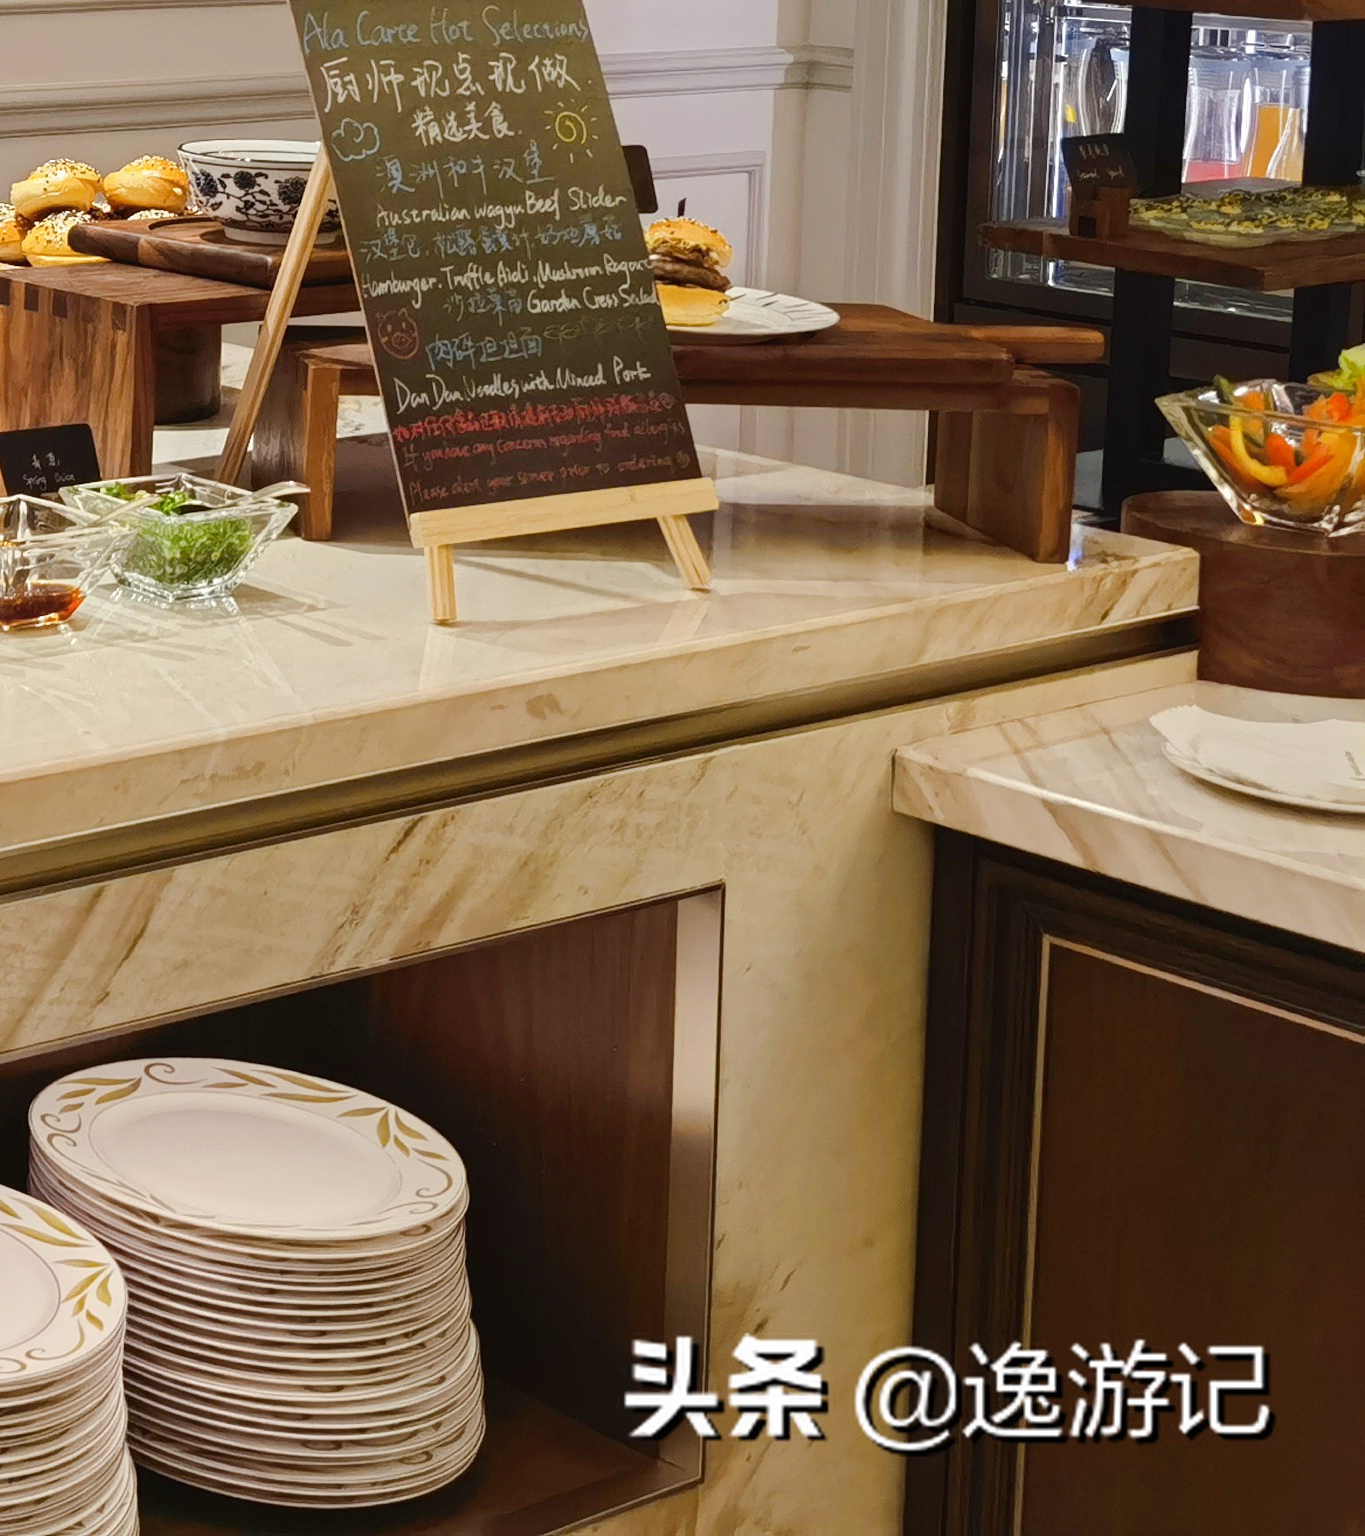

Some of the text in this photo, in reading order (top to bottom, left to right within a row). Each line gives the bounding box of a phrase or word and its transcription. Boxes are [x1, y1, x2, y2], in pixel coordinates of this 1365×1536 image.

[356, 10, 421, 48] Carte
[429, 5, 475, 46] Hot
[481, 4, 590, 47] Selections
[375, 203, 471, 229] Australian
[524, 186, 562, 222] Beef
[567, 184, 628, 212] Slider
[440, 262, 496, 294] Truffle
[392, 376, 429, 415] Dan
[425, 372, 464, 412] Dan
[463, 372, 519, 404] Noodles
[519, 370, 555, 395] with
[611, 354, 653, 385] Pork
